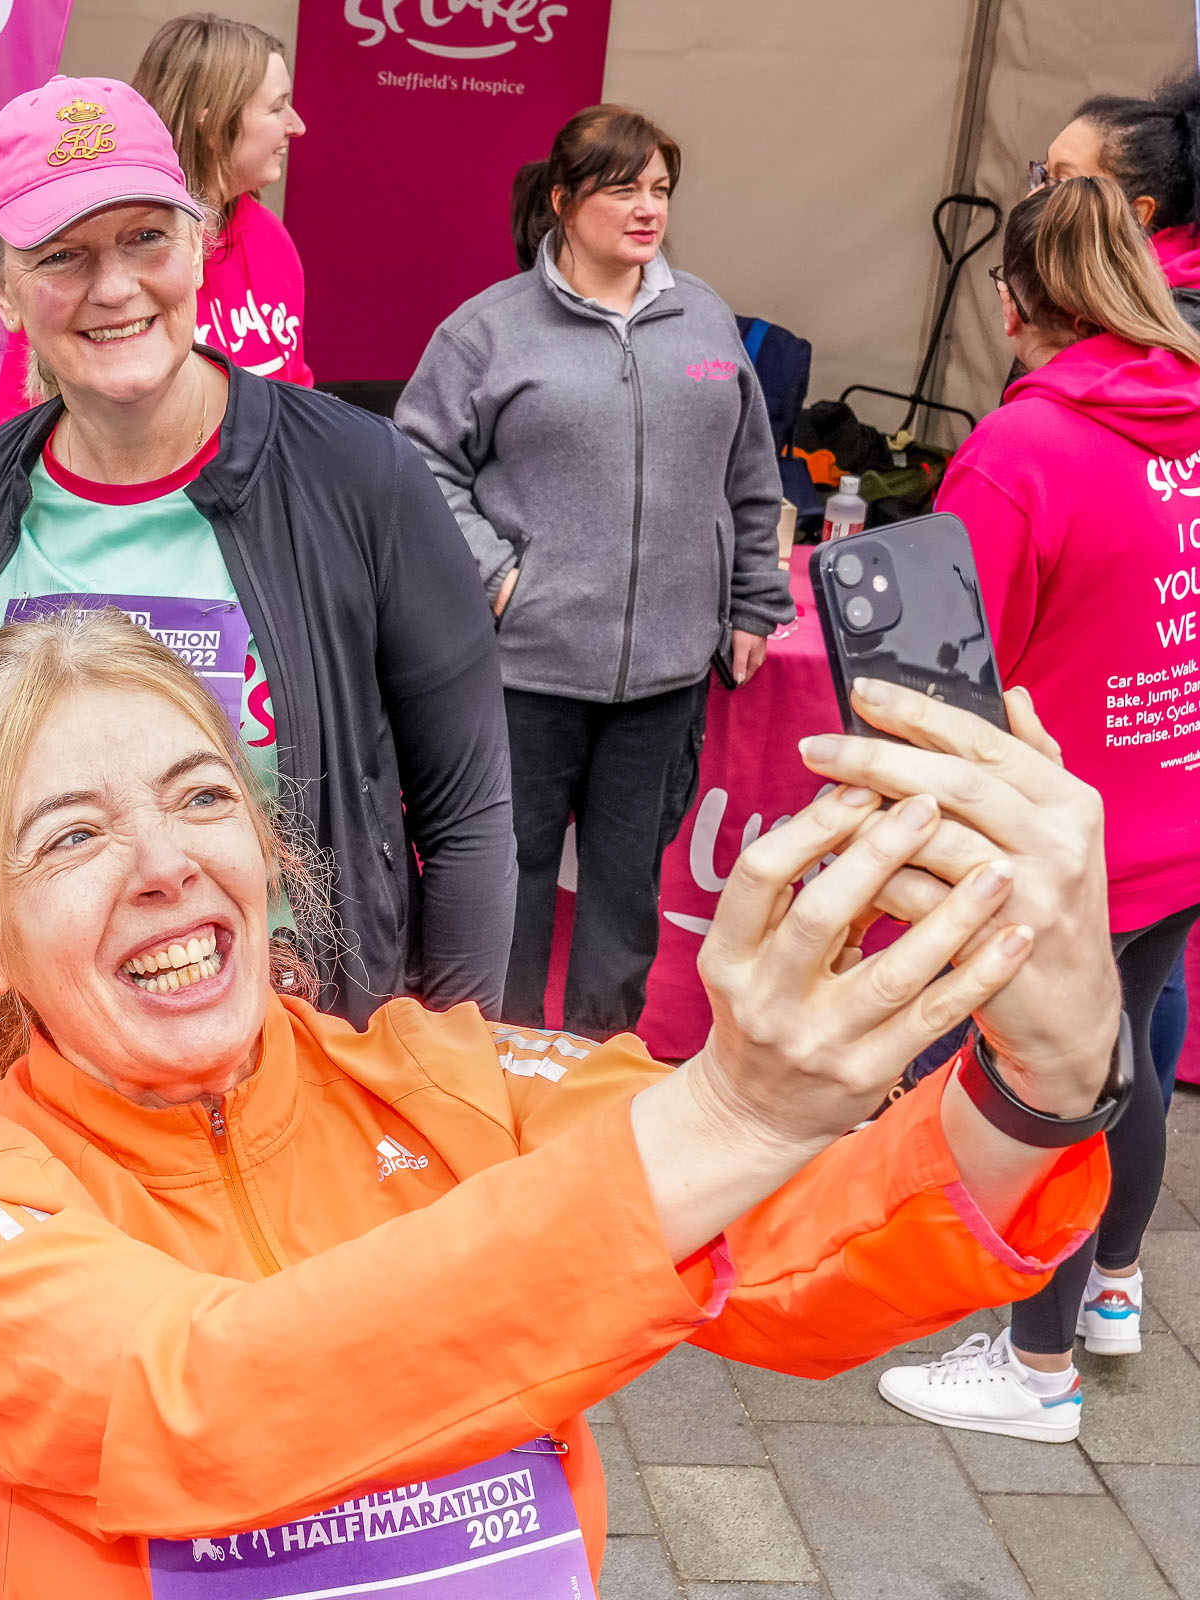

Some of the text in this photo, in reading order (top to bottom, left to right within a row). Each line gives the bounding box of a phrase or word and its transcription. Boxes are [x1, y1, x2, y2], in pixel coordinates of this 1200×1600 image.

[377, 71, 525, 96] Sheffield's Hospice
[155, 632, 217, 647] ATHON
[1156, 611, 1196, 648] WE
[176, 650, 216, 666] 022
[1107, 659, 1199, 689] Car Boot. Walk.
[1106, 693, 1144, 709] Bake.
[1146, 687, 1181, 707] Jump.
[1106, 701, 1197, 728] Eat. Play. Cycle.
[1106, 729, 1171, 747] Fundraise.
[377, 1154, 429, 1182] adidas
[281, 1473, 532, 1552] HALF MARATHON
[466, 1504, 540, 1550] 2022
